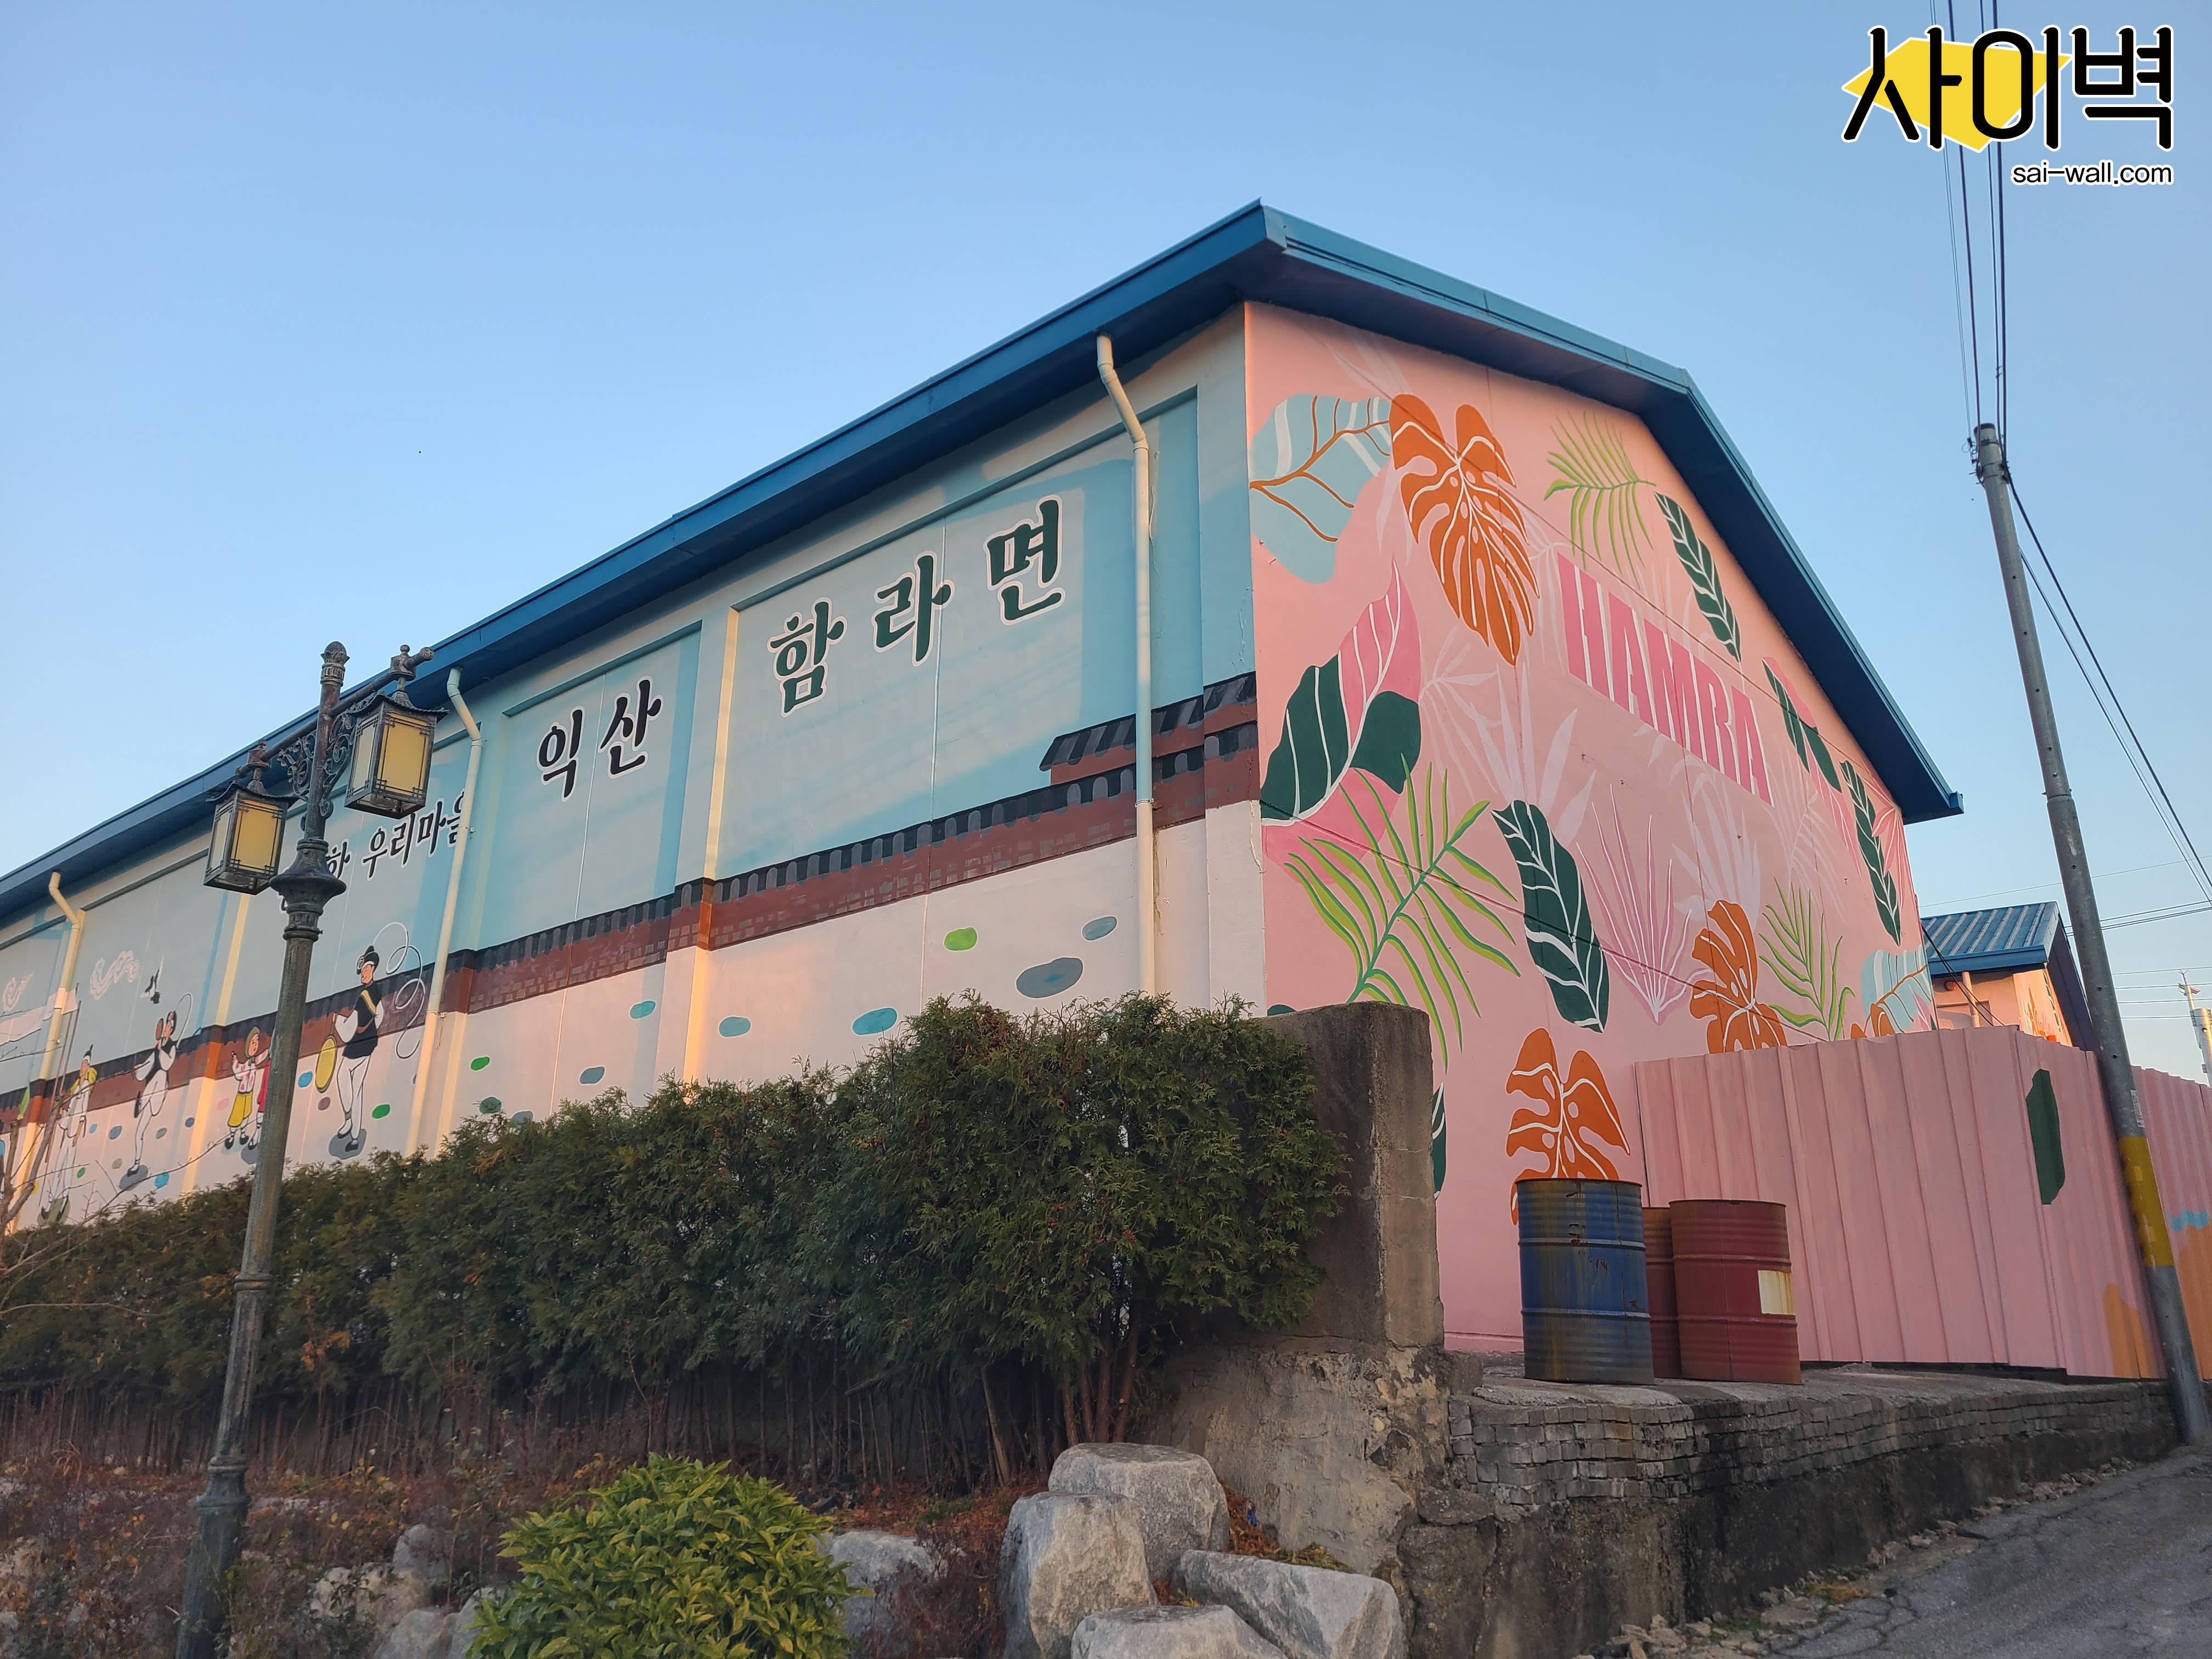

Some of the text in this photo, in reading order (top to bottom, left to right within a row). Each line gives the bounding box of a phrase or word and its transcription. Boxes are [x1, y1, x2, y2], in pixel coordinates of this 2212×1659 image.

[538, 498, 1063, 799] 익산 함라면
[1557, 551, 1776, 808] HAMRA
